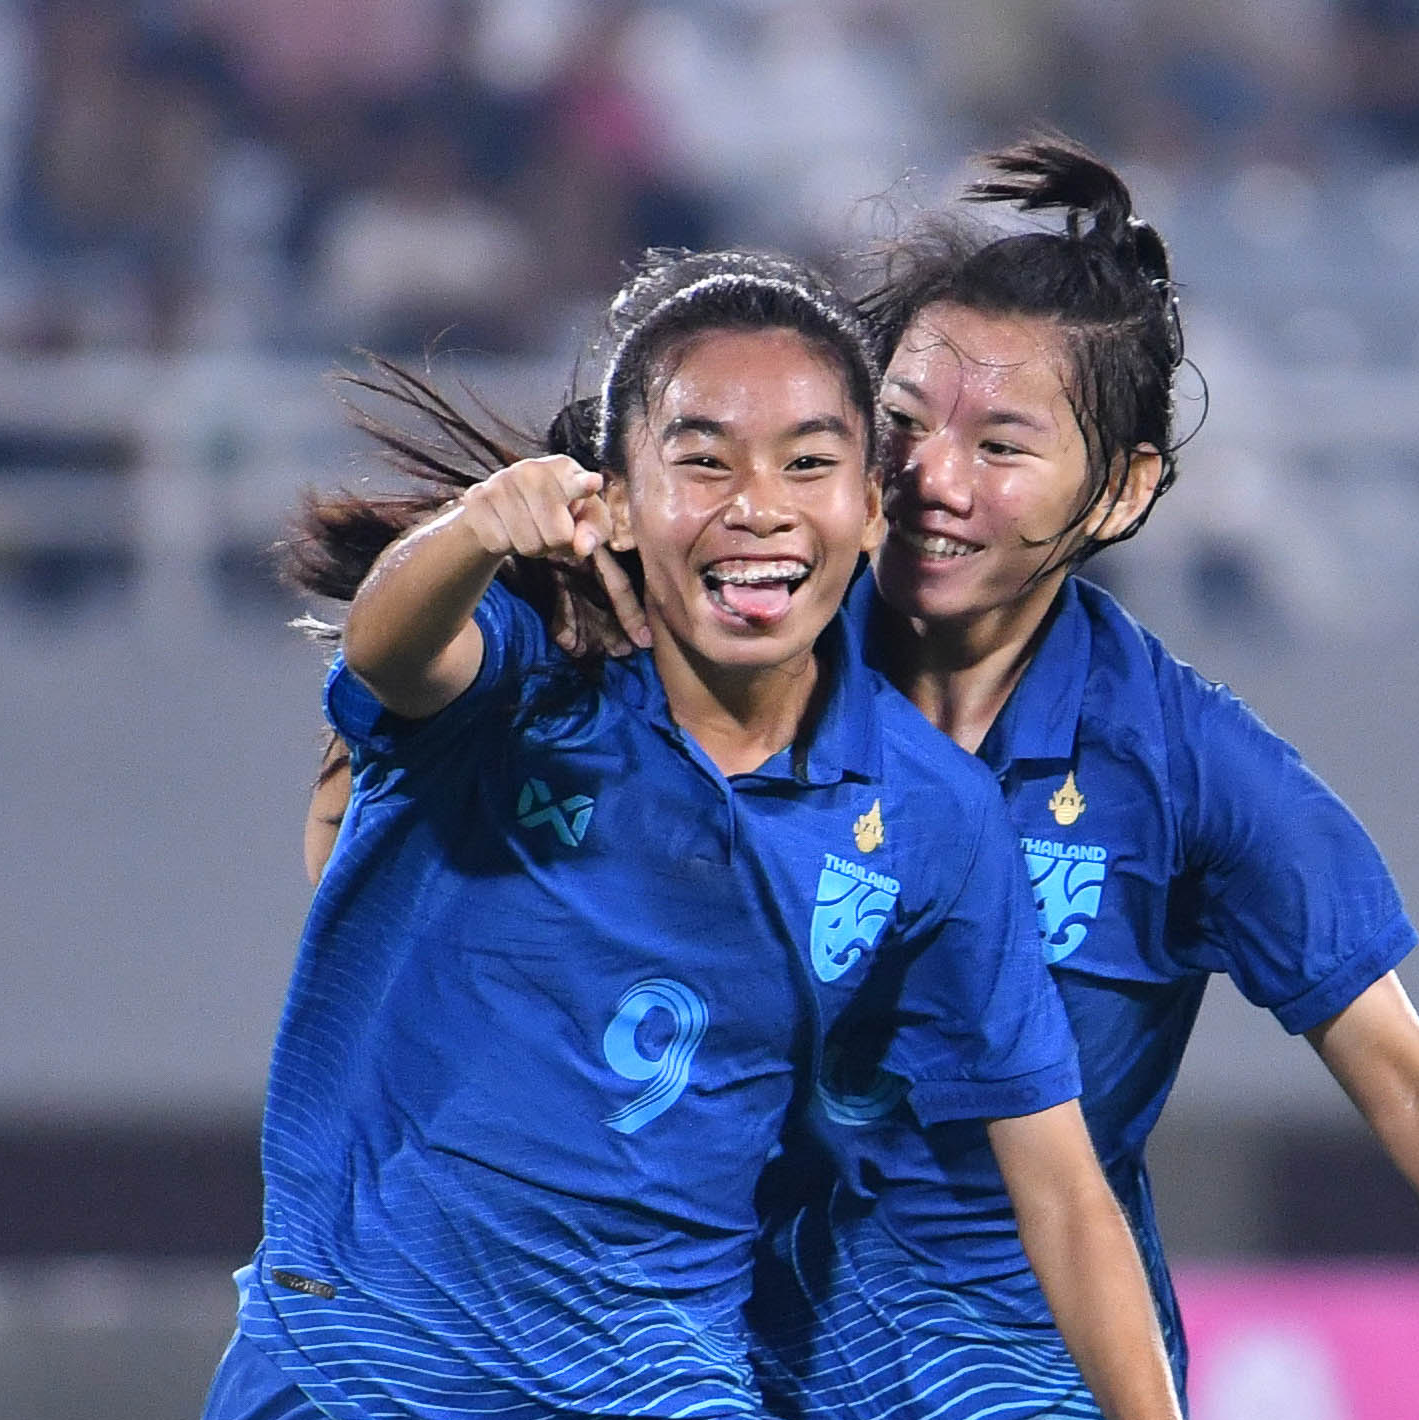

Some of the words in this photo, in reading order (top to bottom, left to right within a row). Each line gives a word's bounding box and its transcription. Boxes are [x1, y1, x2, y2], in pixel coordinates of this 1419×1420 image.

[1019, 837, 1108, 862] THAILAND
[824, 852, 901, 895] THAILAND
[600, 977, 710, 1134] 9
